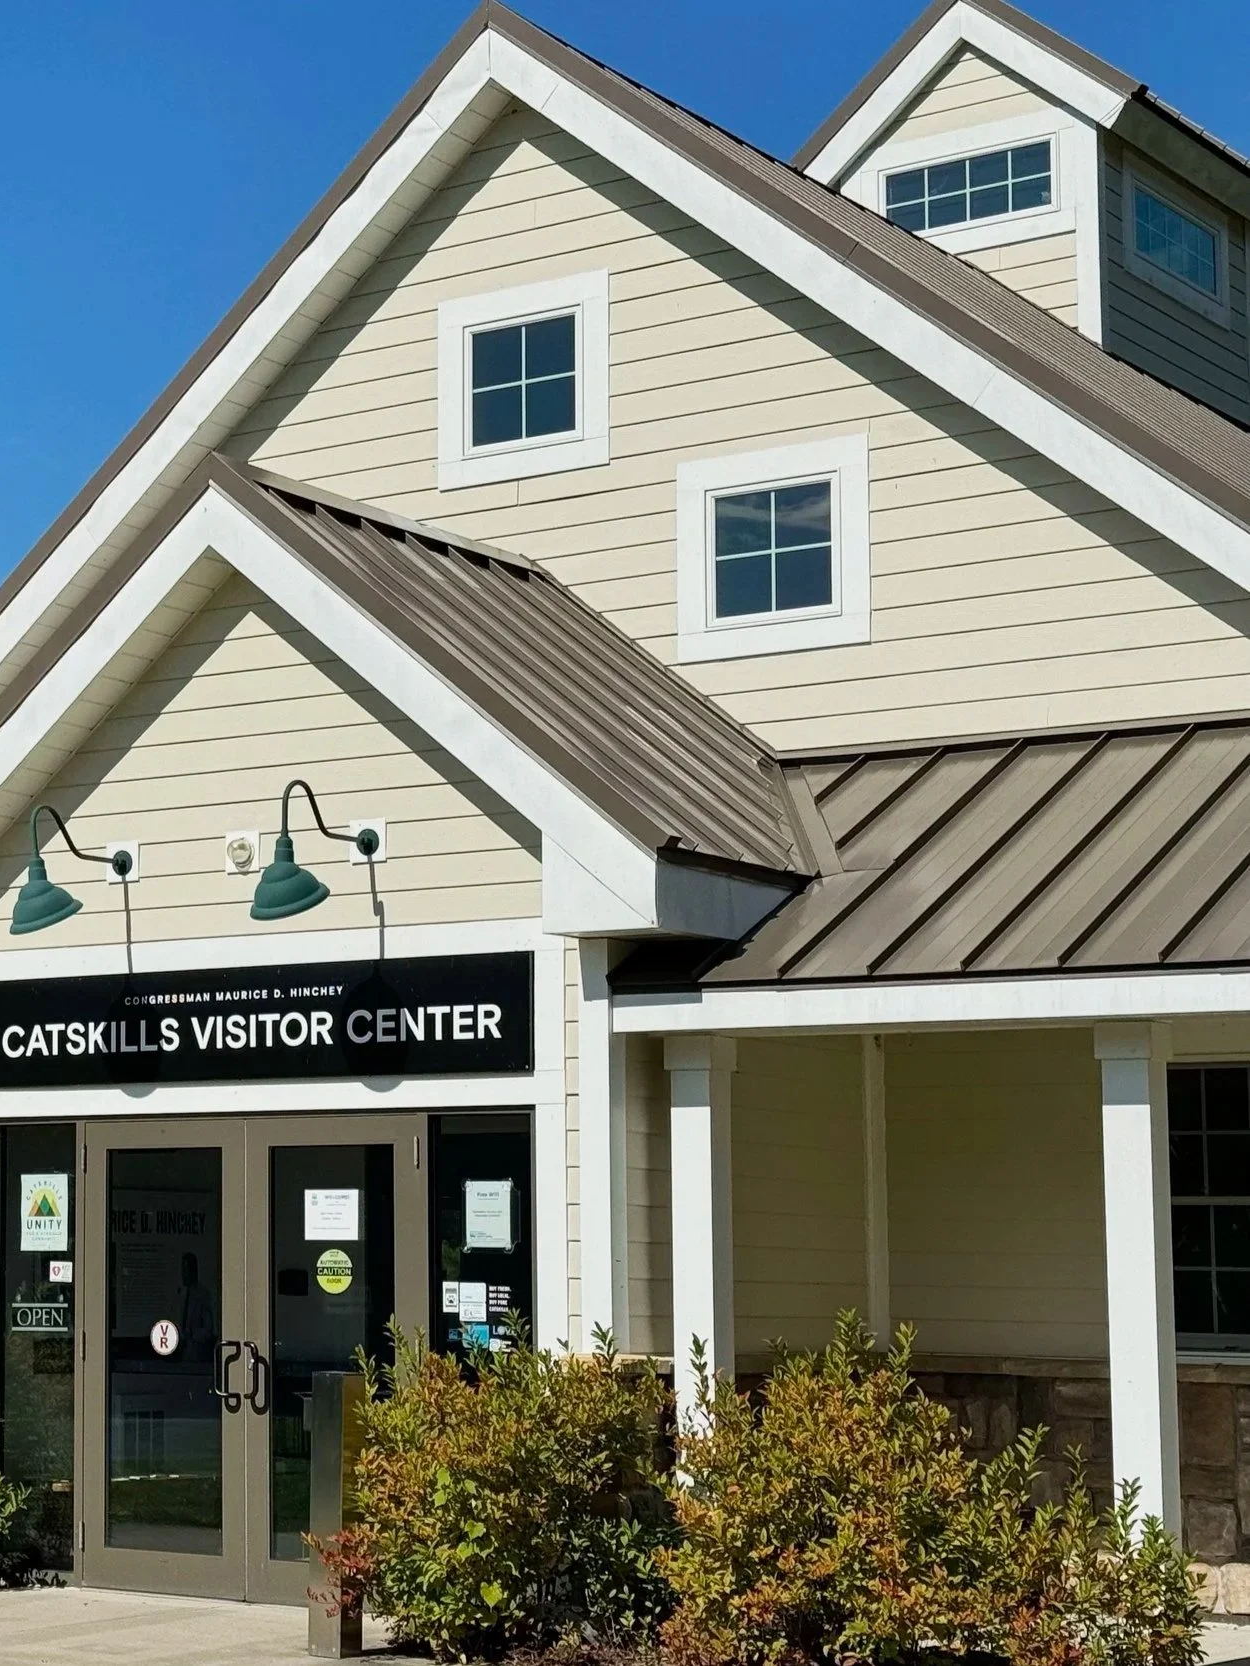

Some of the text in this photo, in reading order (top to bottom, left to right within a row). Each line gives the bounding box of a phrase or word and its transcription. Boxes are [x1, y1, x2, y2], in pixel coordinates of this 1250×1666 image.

[125, 985, 343, 1006] CONGRESSMAN MAURICE D. HINCHEY
[2, 1004, 502, 1059] CATSKILLS VISITOR CENTER
[26, 1219, 62, 1230] UNITY
[317, 1267, 352, 1276] CAUTION
[17, 1308, 64, 1326] OPEN
